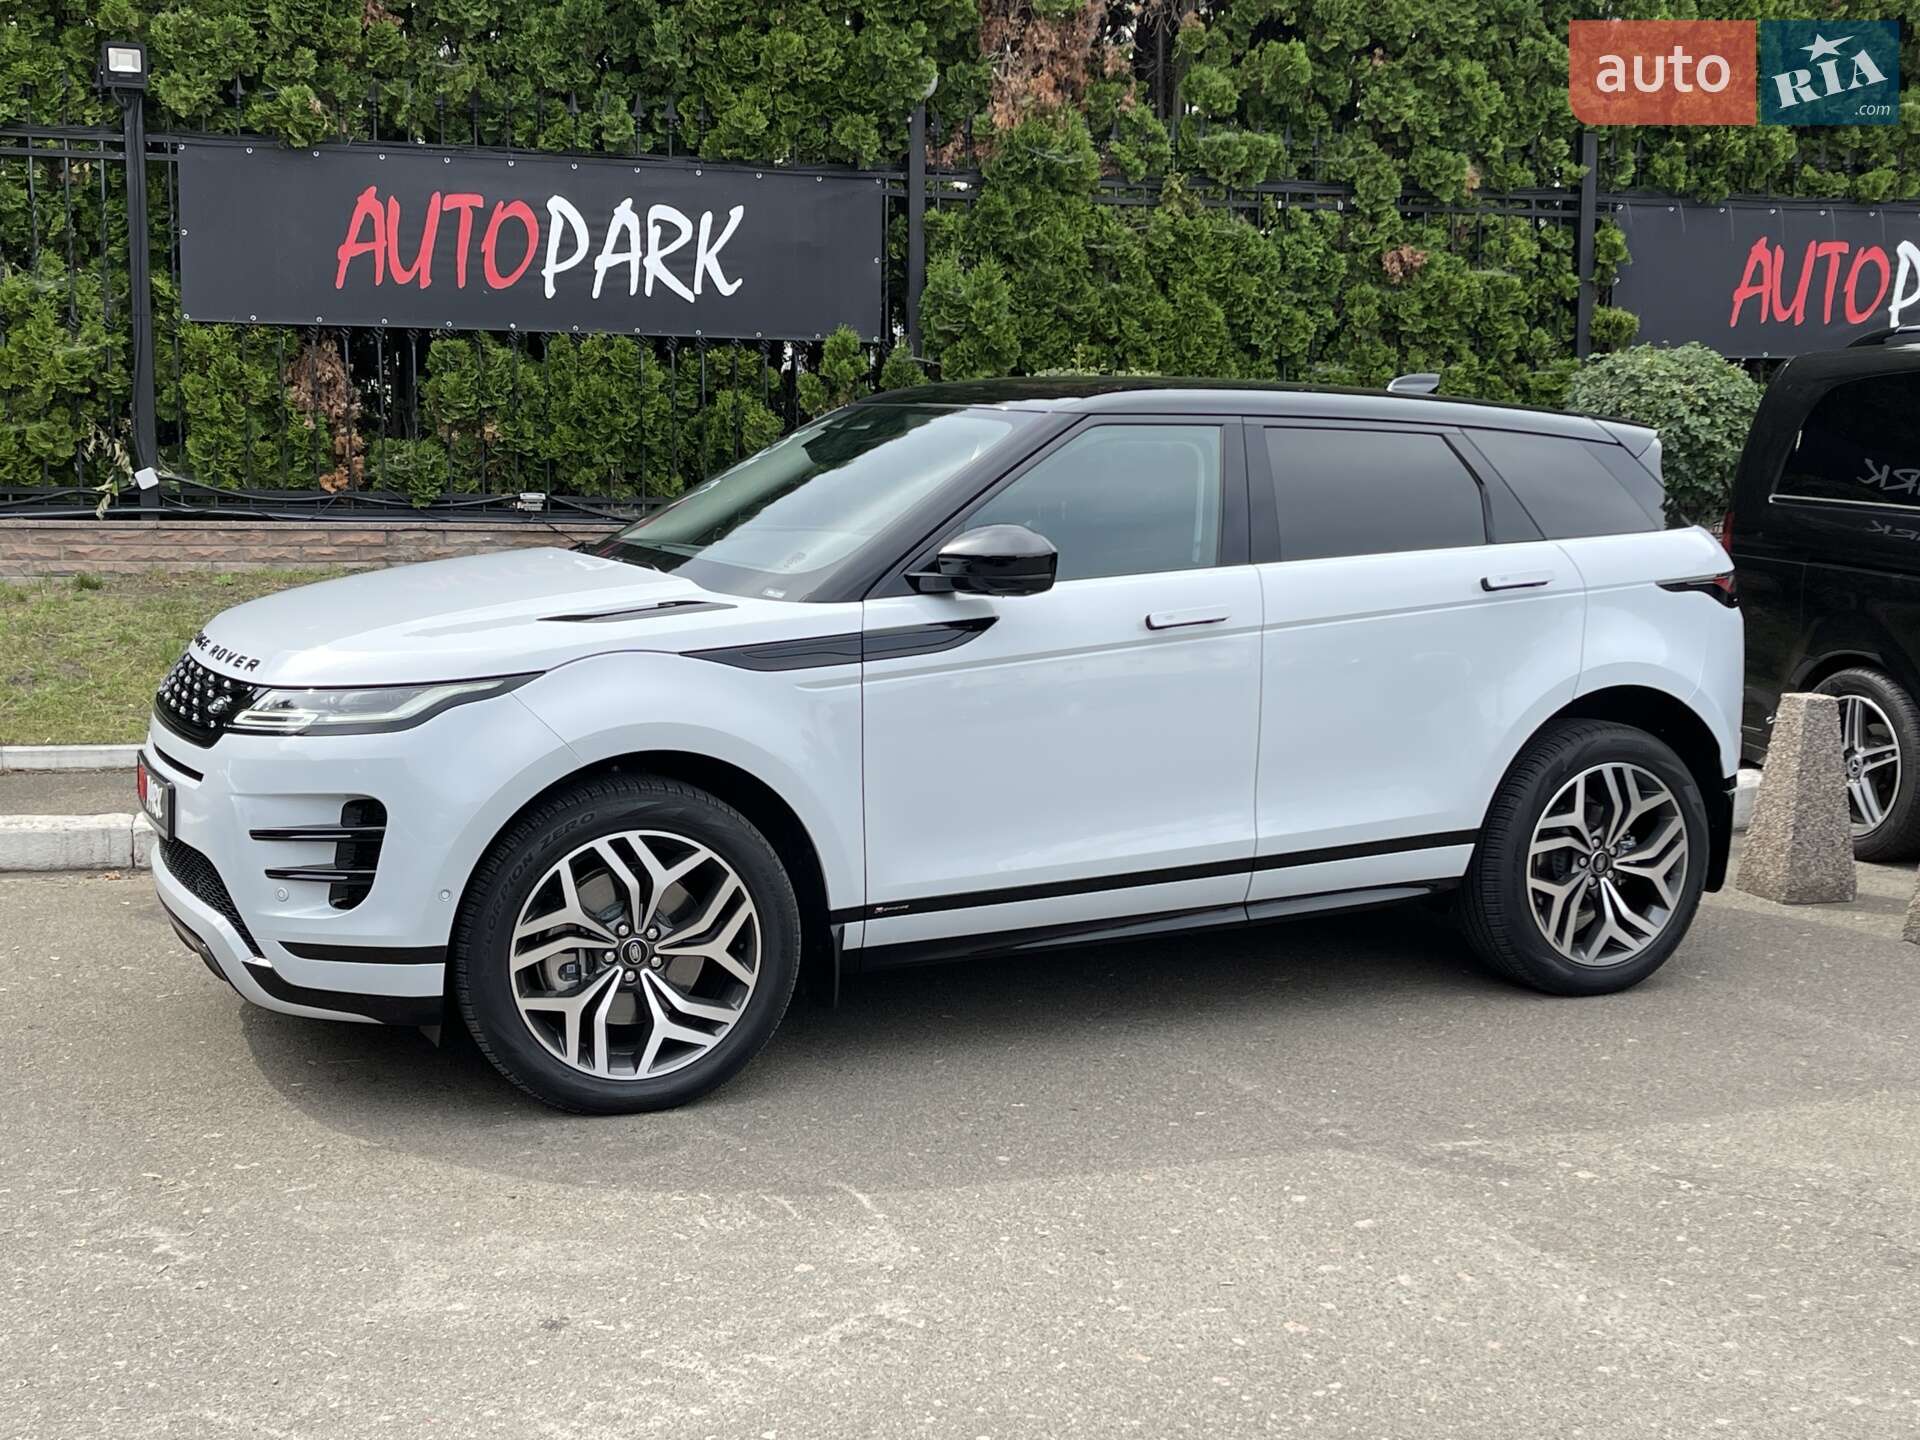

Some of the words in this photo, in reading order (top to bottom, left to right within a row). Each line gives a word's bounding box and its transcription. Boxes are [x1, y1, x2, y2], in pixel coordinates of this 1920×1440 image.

[335, 185, 744, 303] AUTOPARK
[209, 644, 261, 672] ROVER
[537, 810, 596, 852] ZERO
